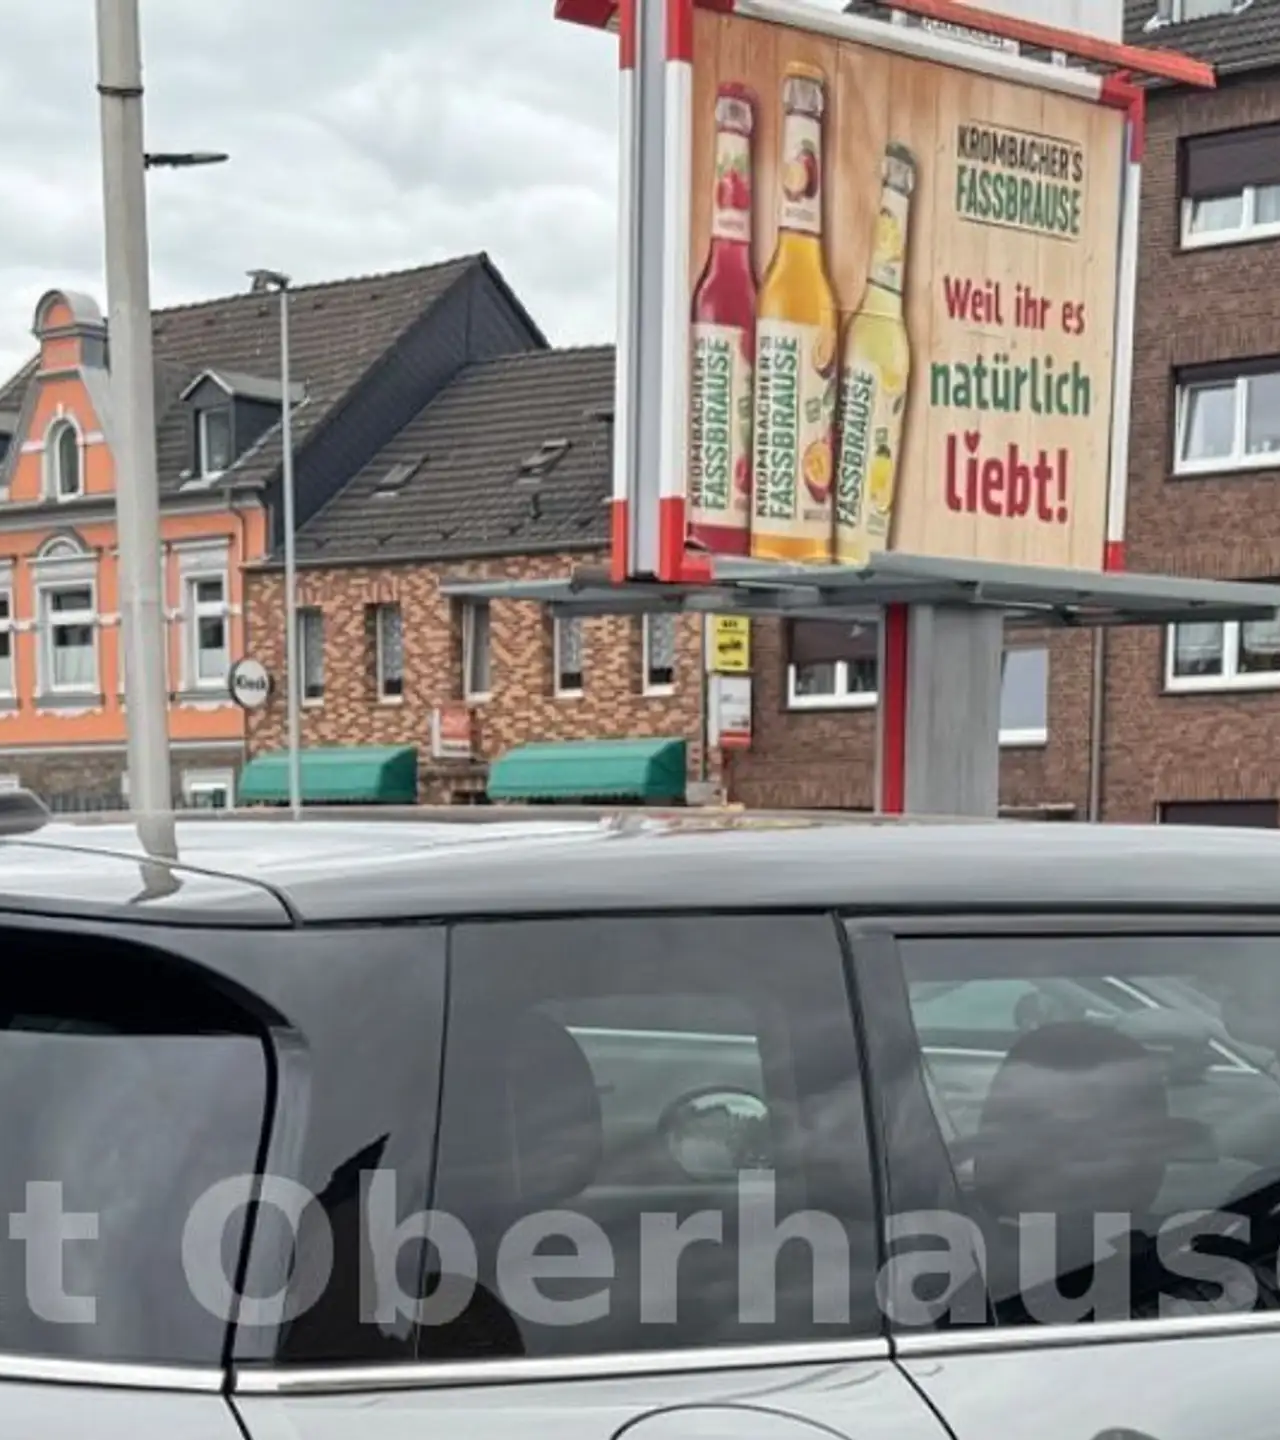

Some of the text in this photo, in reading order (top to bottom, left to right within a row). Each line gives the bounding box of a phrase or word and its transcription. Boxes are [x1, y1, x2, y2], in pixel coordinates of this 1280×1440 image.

[957, 125, 1083, 183] KROMBACHER'S
[955, 165, 1081, 235] FASSBRAUSE
[943, 275, 1086, 336] Weil ihr es
[704, 339, 730, 511] FASSBRAUSE
[929, 353, 1091, 417] natürlich
[770, 336, 798, 520] FASSBRAUSE
[835, 369, 873, 528] FASSBRAUSE
[944, 430, 1069, 525] liebt!
